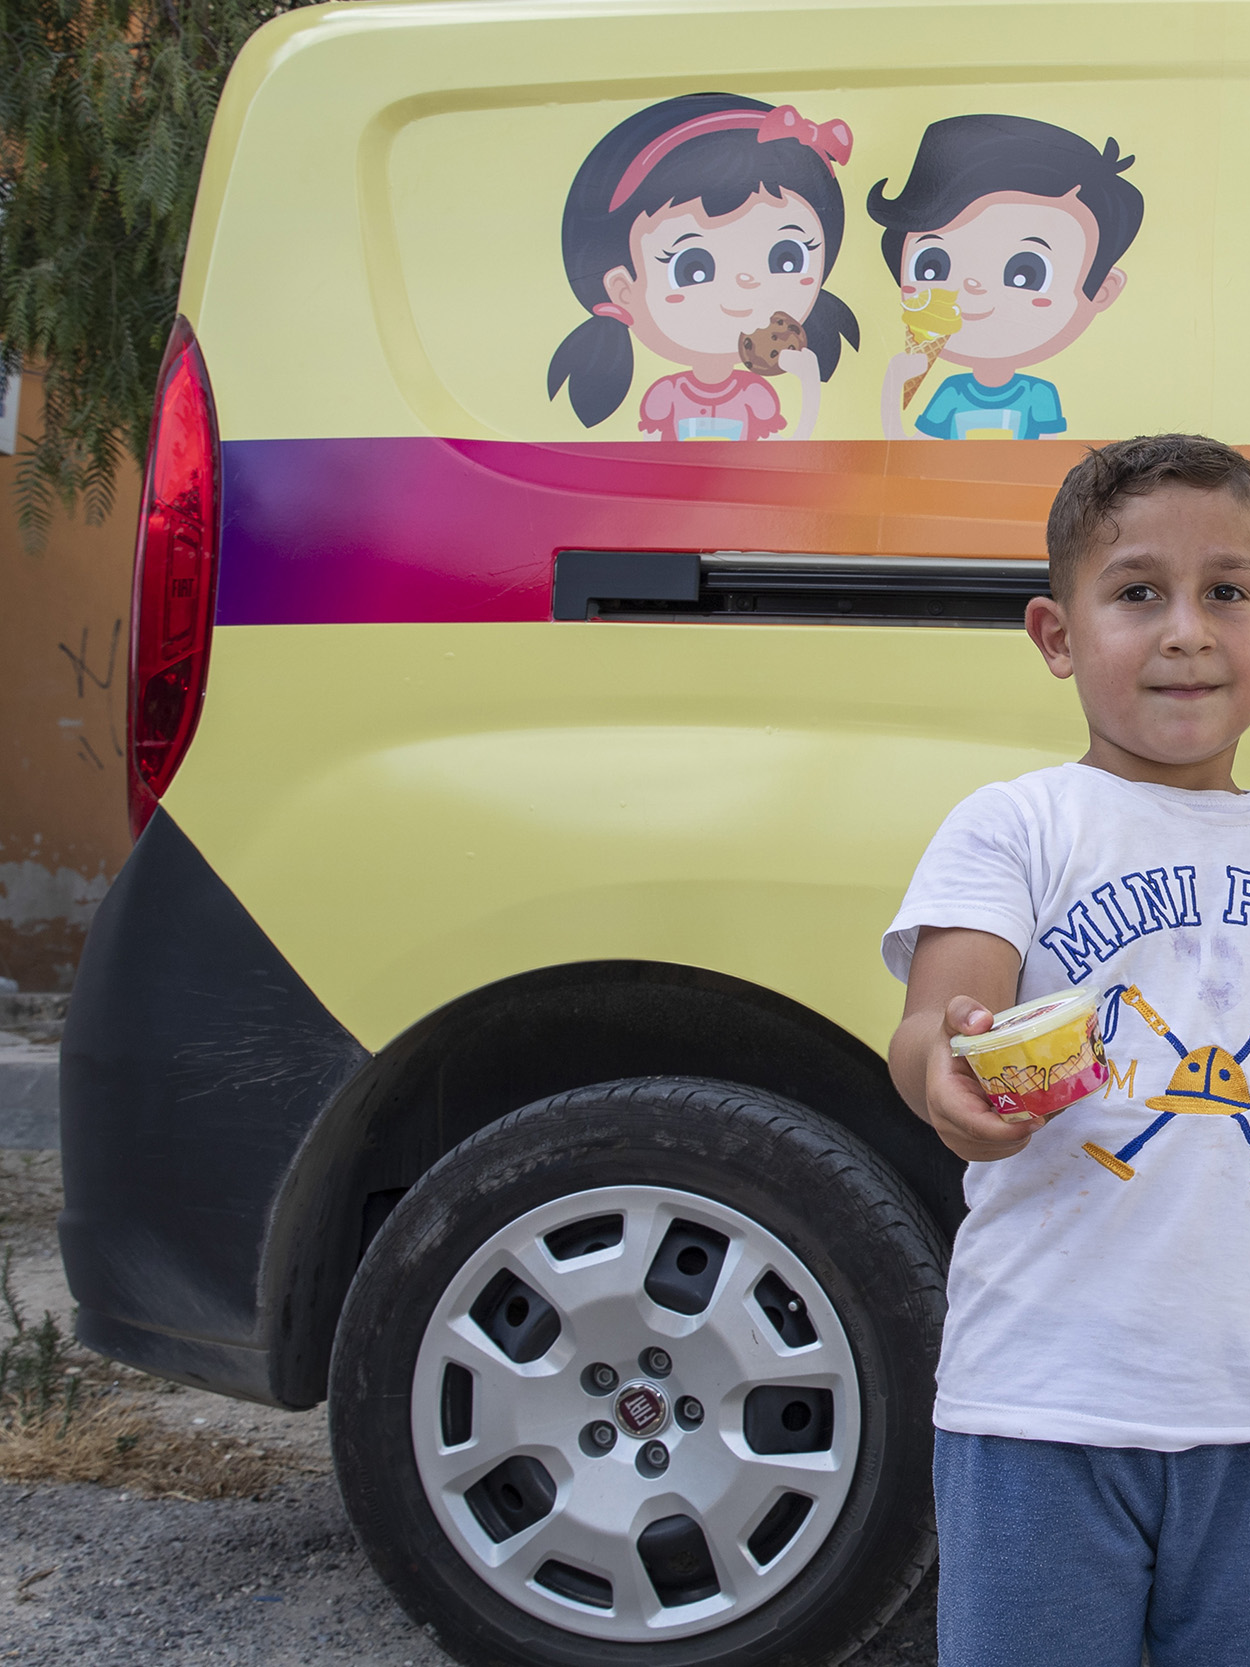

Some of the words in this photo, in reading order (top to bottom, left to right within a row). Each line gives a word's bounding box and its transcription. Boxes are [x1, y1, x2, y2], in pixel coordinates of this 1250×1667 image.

[1039, 865, 1202, 985] MINI
[1105, 1058, 1136, 1100] M
[625, 1395, 656, 1426] FIAT
